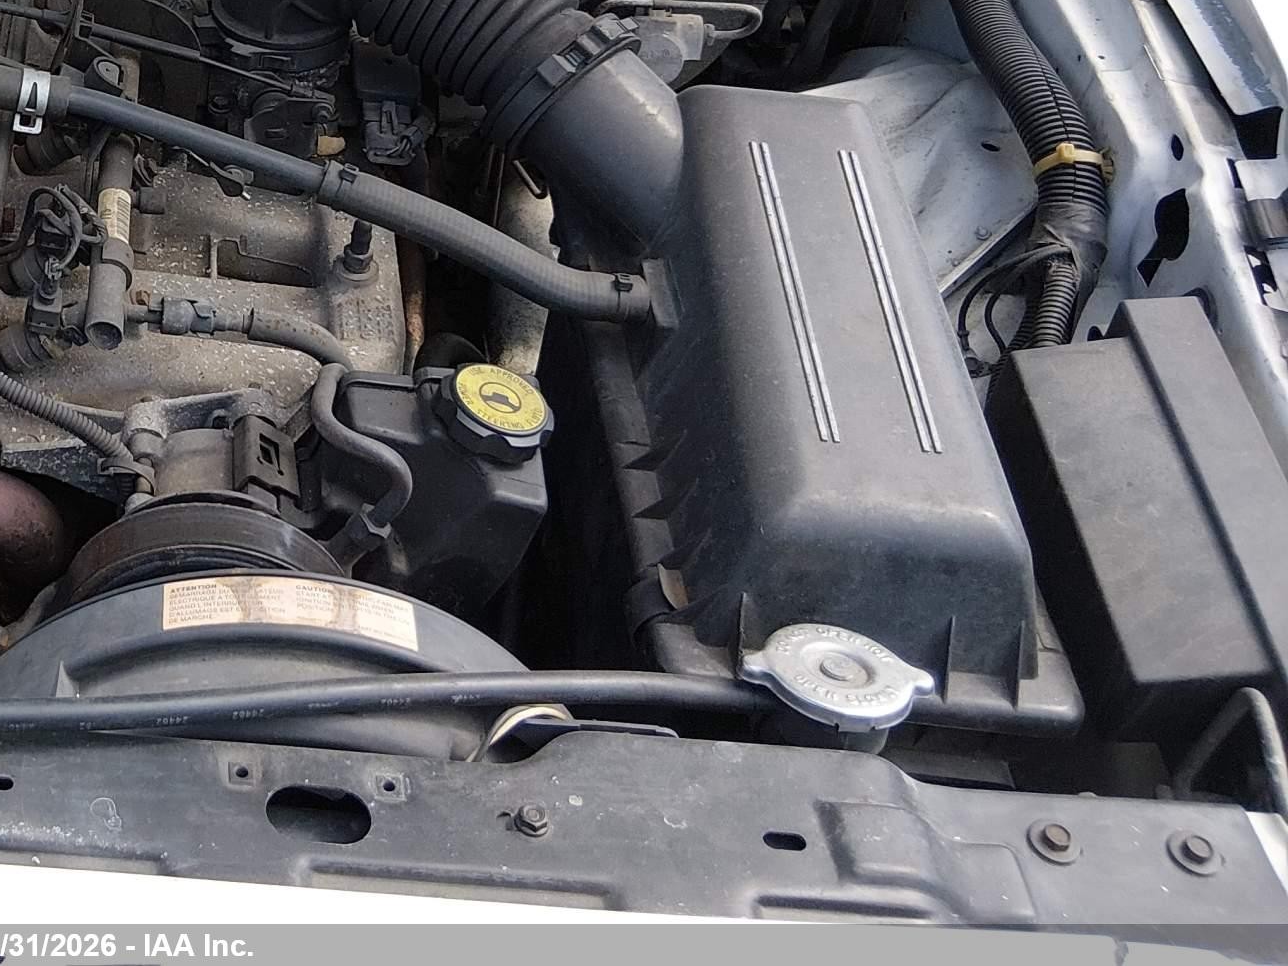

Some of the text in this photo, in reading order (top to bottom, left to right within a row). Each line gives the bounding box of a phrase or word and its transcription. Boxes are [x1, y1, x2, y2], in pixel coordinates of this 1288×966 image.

[490, 368, 535, 396] APPROVED
[171, 584, 216, 593] ATTENTION
[816, 627, 860, 644] OPEN
